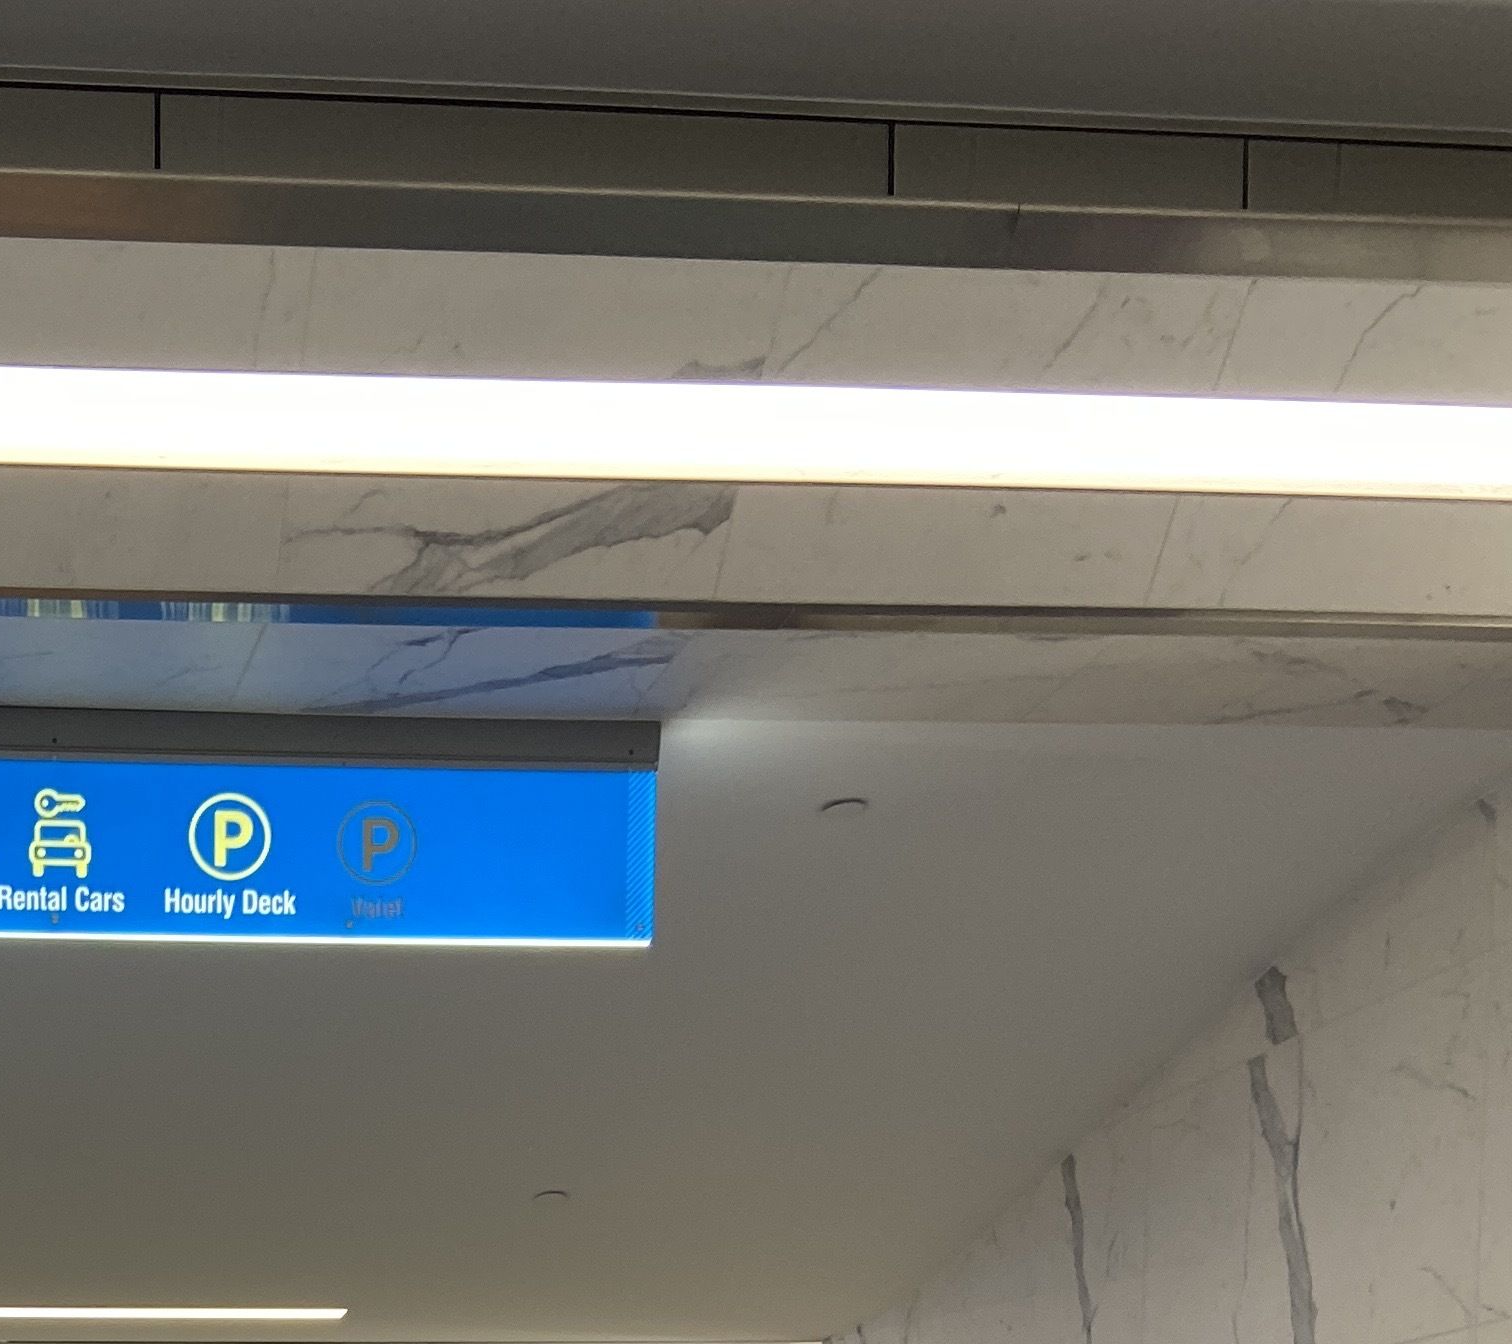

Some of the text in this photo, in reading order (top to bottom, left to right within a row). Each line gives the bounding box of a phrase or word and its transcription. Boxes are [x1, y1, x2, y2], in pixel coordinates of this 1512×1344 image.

[213, 810, 254, 868] P
[74, 887, 126, 913] Cars
[164, 888, 297, 920] Hourly Deck
